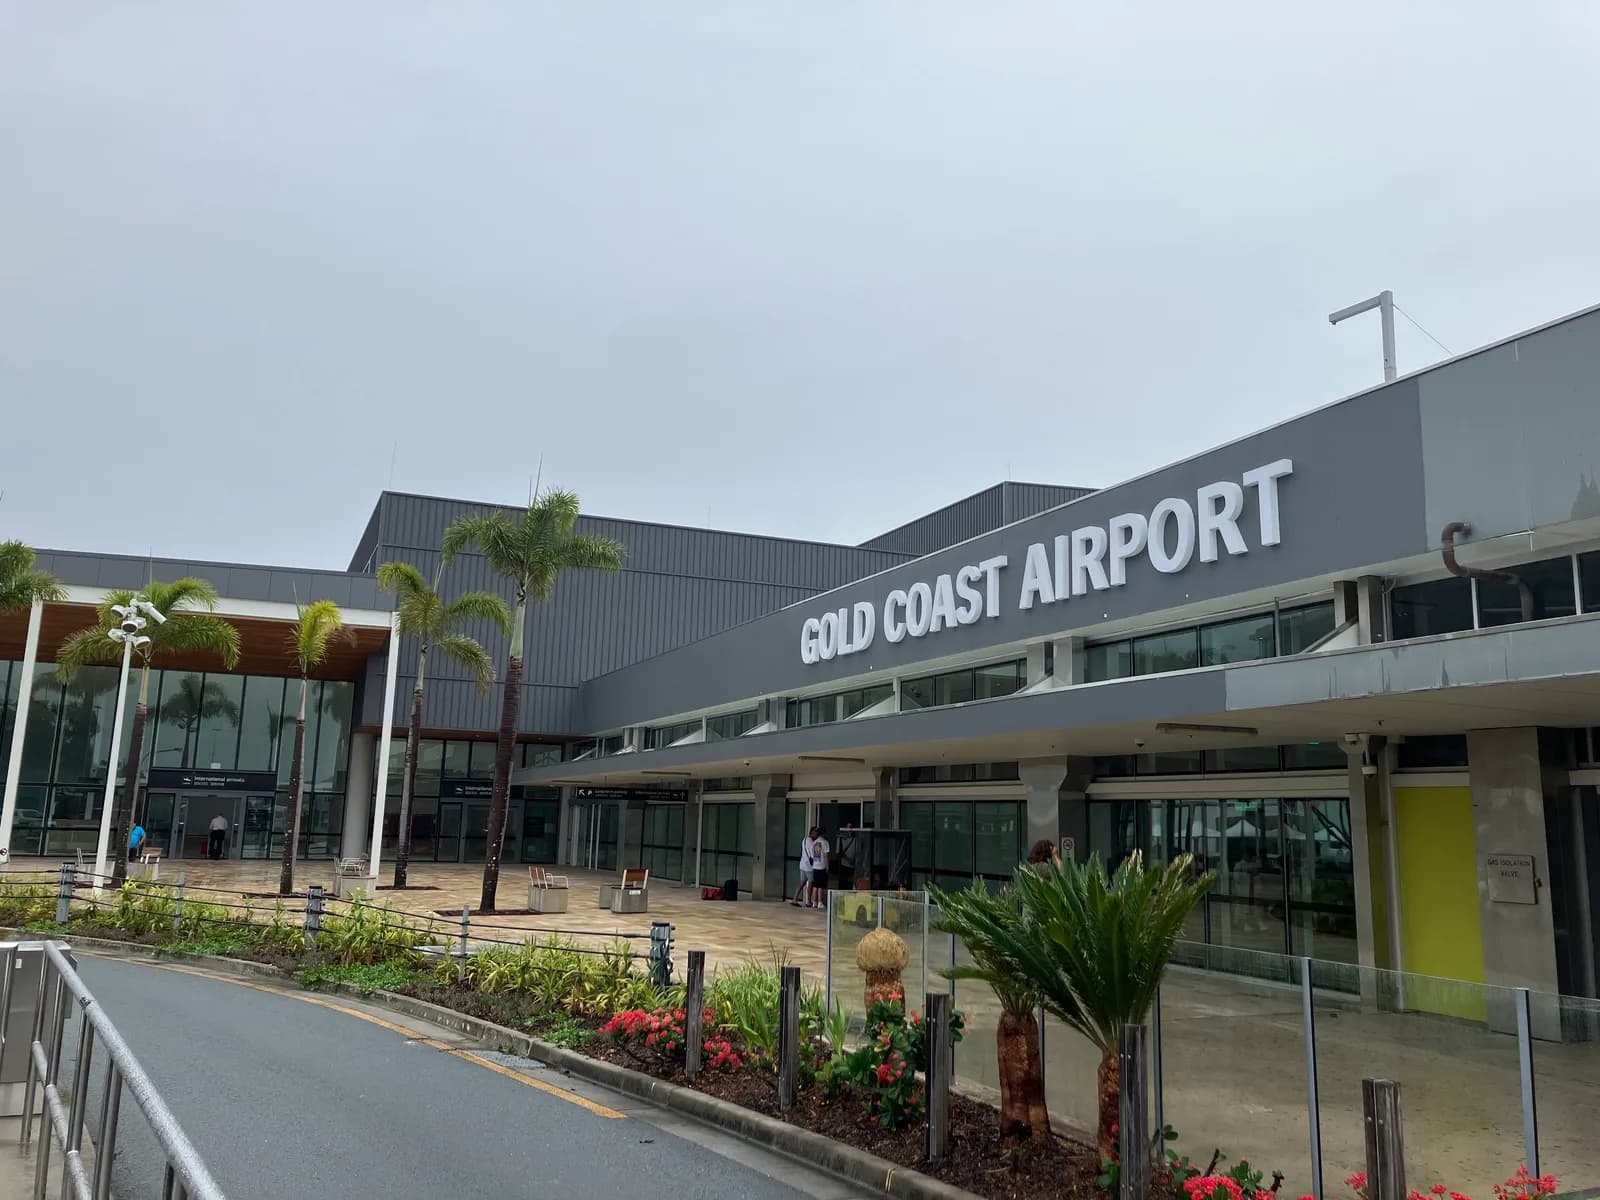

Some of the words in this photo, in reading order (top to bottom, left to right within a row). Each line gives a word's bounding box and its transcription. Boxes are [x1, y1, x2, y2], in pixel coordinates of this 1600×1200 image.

[801, 601, 875, 664] GOLD
[883, 555, 1008, 643] COAST
[1019, 458, 1293, 610] AIRPORT
